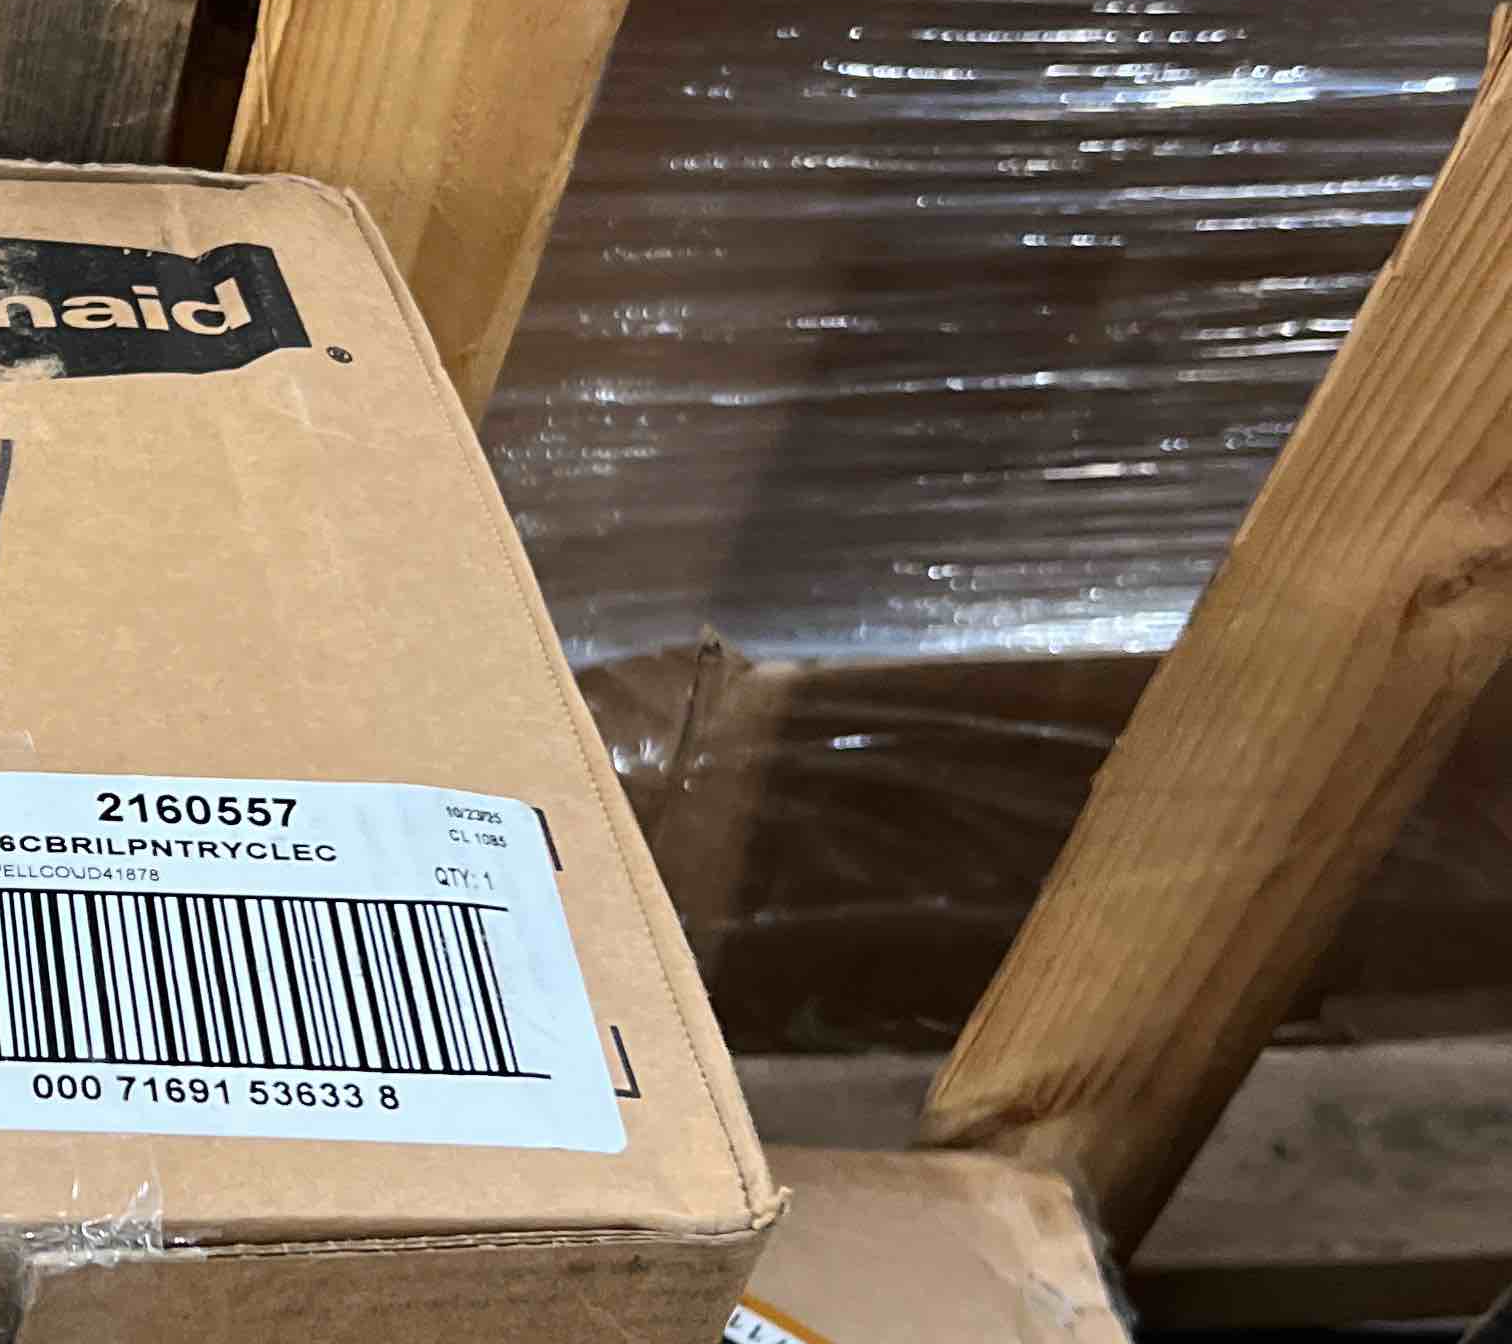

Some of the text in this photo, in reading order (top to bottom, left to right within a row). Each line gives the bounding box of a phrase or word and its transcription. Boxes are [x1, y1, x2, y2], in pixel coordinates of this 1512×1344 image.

[96, 792, 298, 827] 2160557
[434, 867, 494, 890] QTY: 1
[32, 1074, 400, 1110] 000 71691 53633 8
